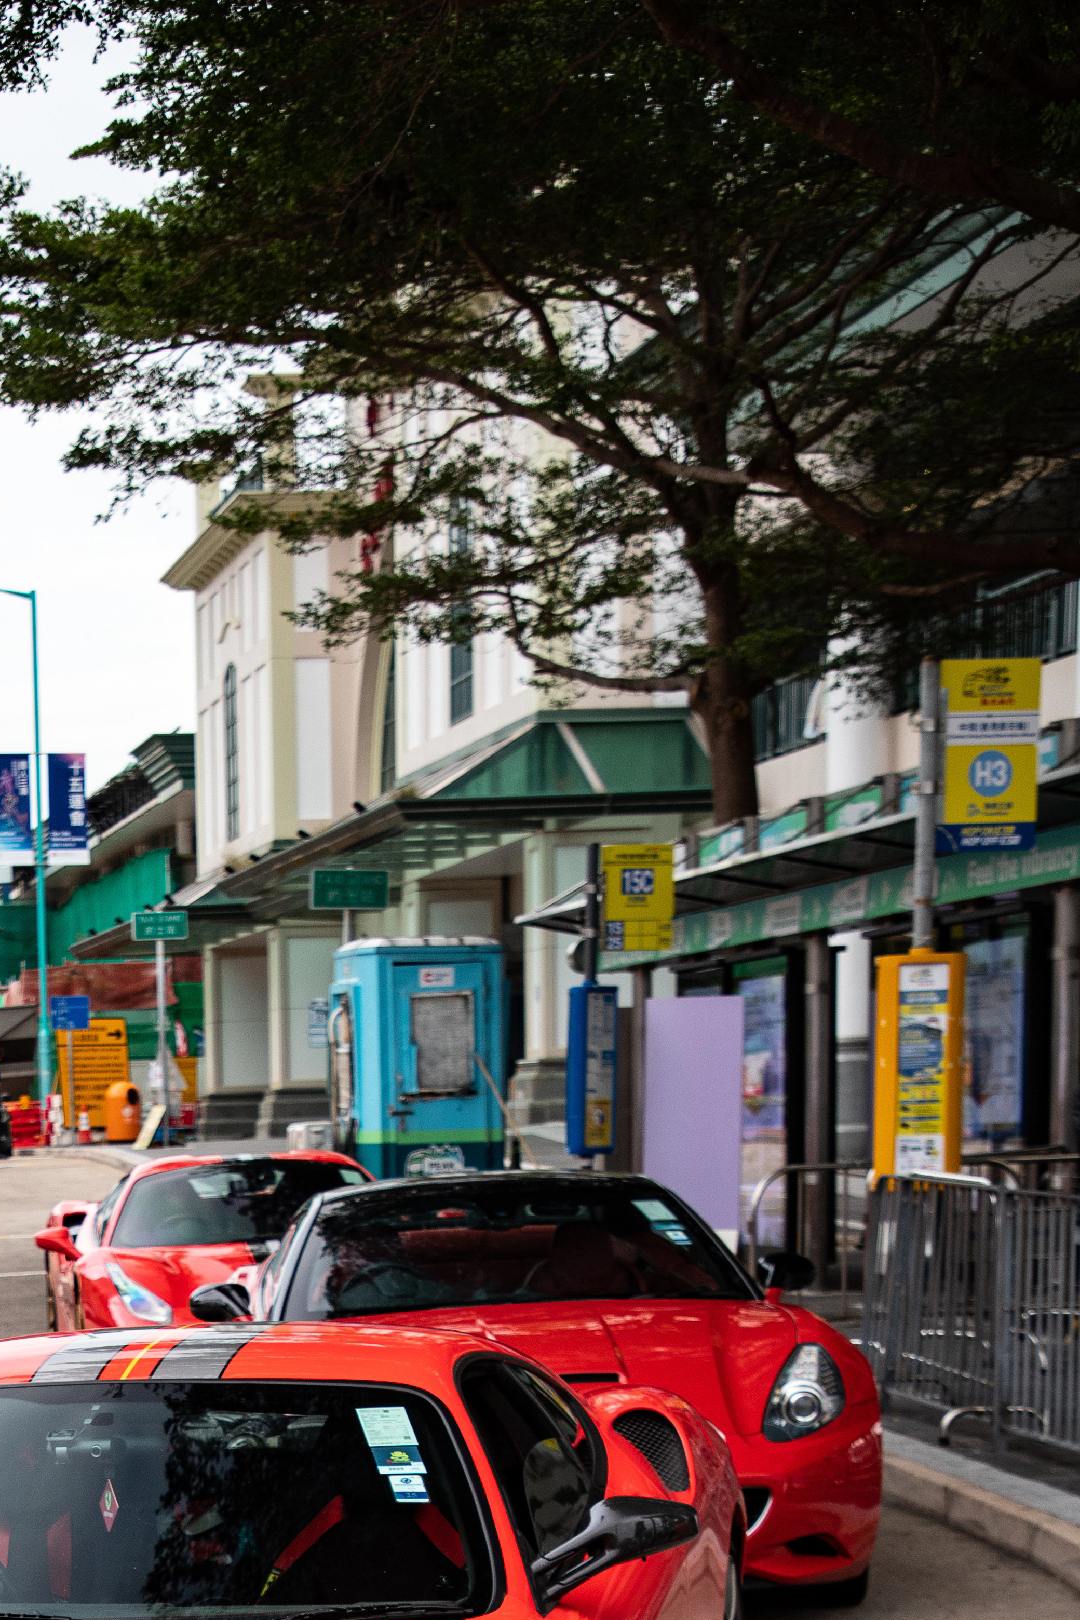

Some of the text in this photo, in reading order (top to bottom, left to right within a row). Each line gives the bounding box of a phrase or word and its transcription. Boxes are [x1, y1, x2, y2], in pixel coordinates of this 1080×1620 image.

[975, 759, 1009, 787] H3
[68, 761, 86, 827] 十五運會
[624, 869, 654, 894] 15C
